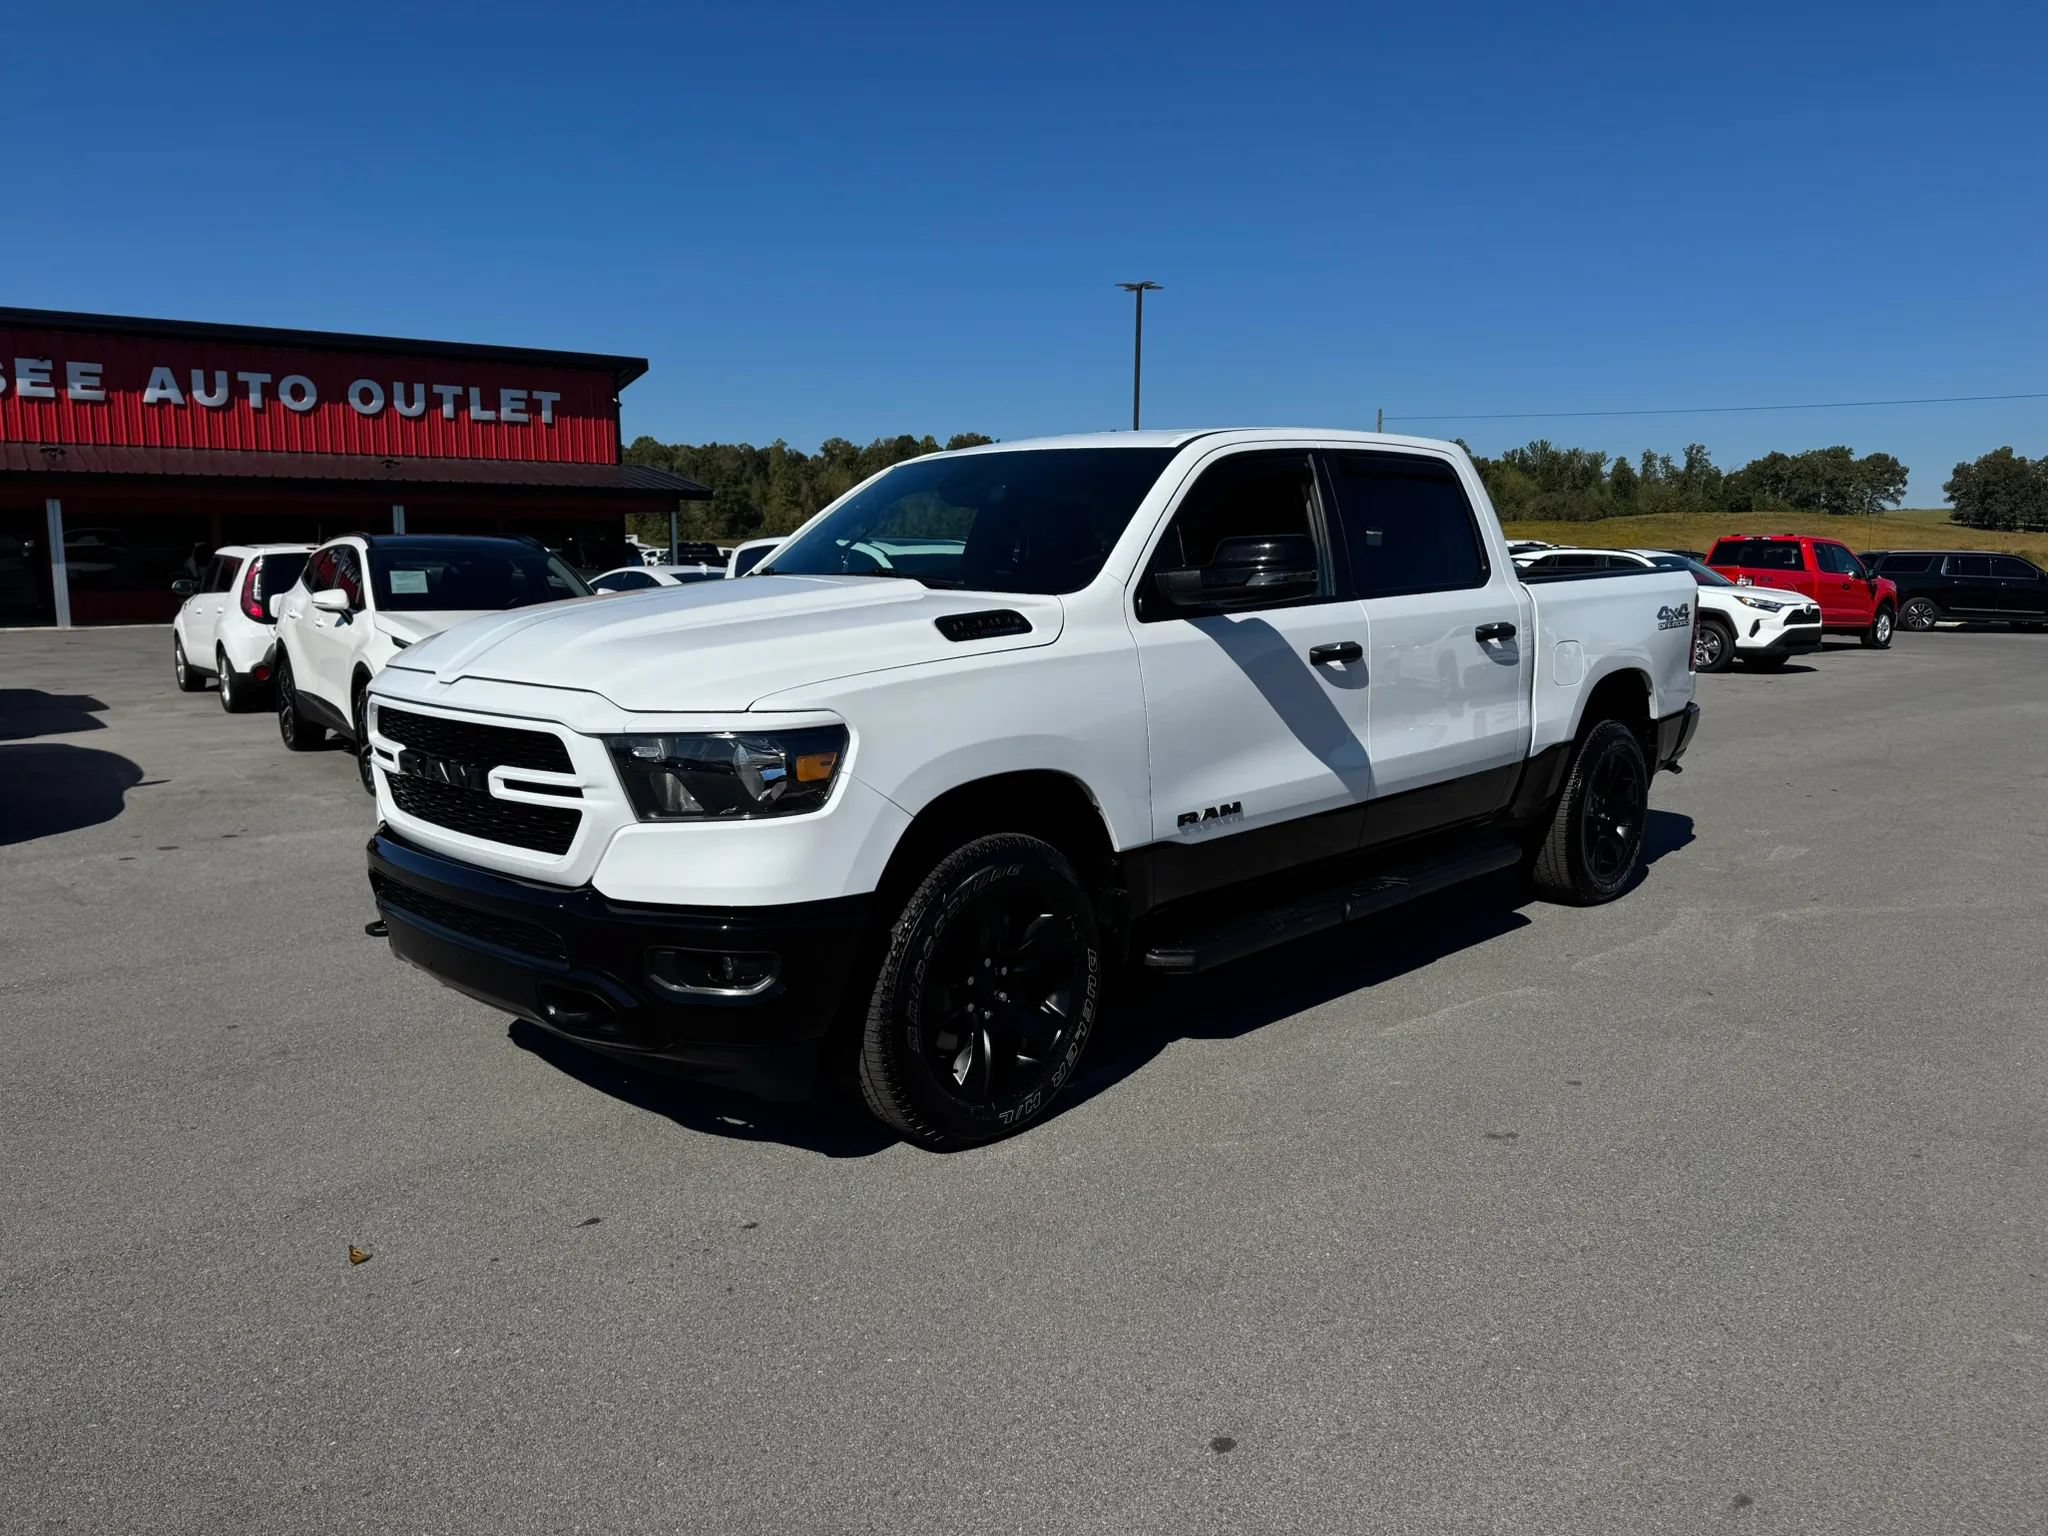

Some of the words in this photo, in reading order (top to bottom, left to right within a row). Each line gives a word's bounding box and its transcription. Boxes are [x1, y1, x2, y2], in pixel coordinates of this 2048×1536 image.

[0, 358, 106, 400] EE
[143, 366, 317, 411] AUTO
[347, 378, 561, 424] OUTLET
[1177, 801, 1242, 827] RAM
[1052, 948, 1098, 1088] DUELER
